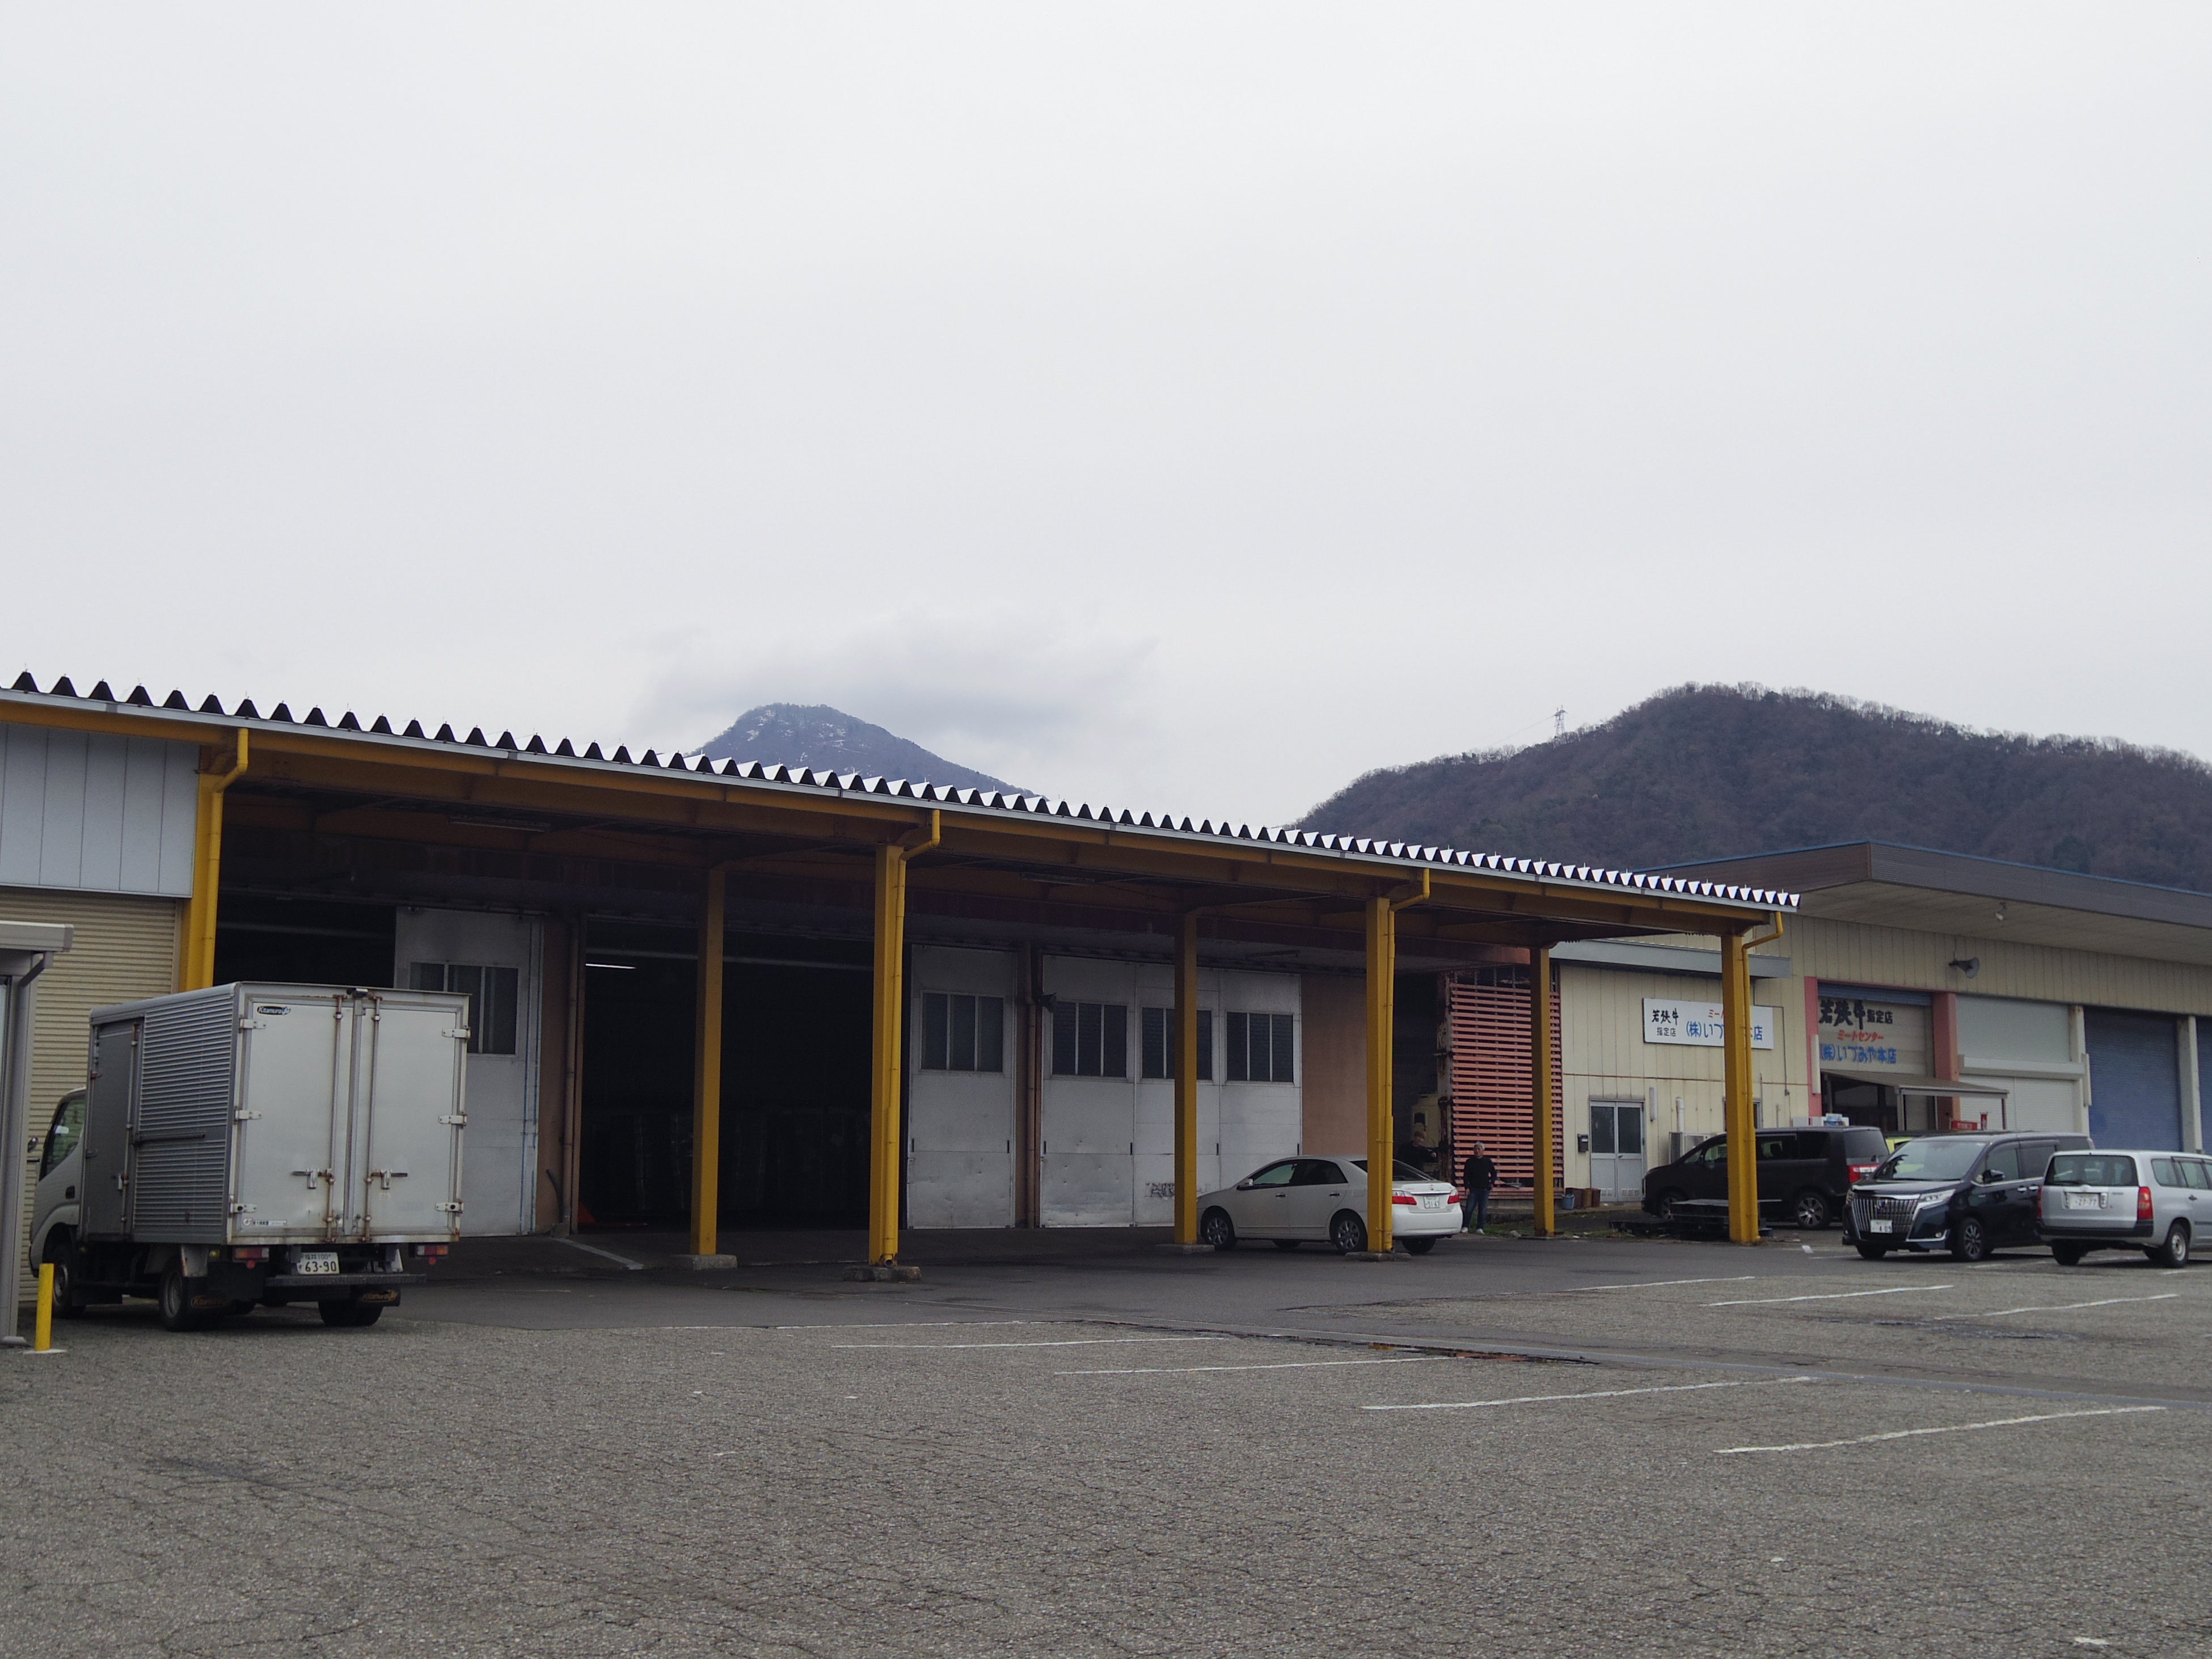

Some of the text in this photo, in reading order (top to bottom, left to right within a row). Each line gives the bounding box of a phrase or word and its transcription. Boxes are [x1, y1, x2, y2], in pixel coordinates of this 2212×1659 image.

[1652, 1008, 1679, 1025] 若狭牛
[1708, 1009, 1724, 1019] ミー
[1657, 1027, 1676, 1037] 指定店
[1838, 1029, 1884, 1042] ミートセンター
[305, 1261, 336, 1272] 63-90
